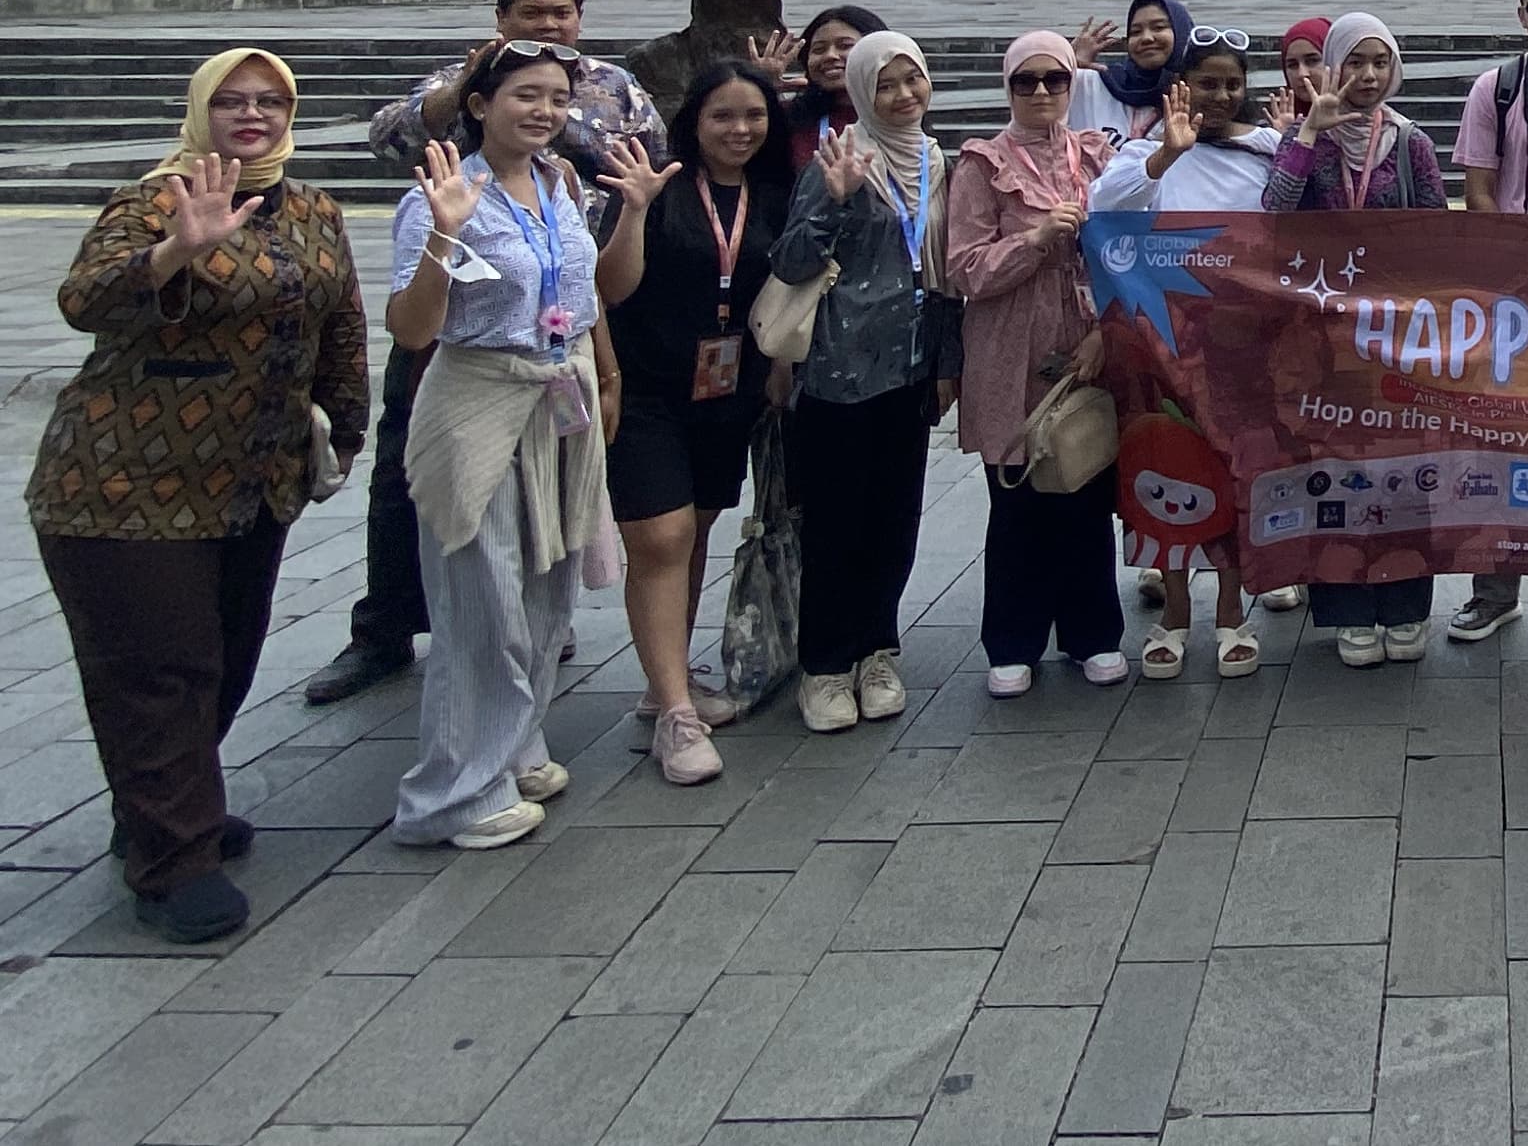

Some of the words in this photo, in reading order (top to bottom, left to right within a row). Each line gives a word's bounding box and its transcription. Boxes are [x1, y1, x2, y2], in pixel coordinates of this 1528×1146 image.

[1143, 235, 1200, 251] Global
[1144, 252, 1235, 268] Volunteer
[1299, 394, 1353, 428] Hop
[1360, 408, 1393, 429] on
[1400, 407, 1442, 431] the
[1497, 540, 1521, 551] stop
